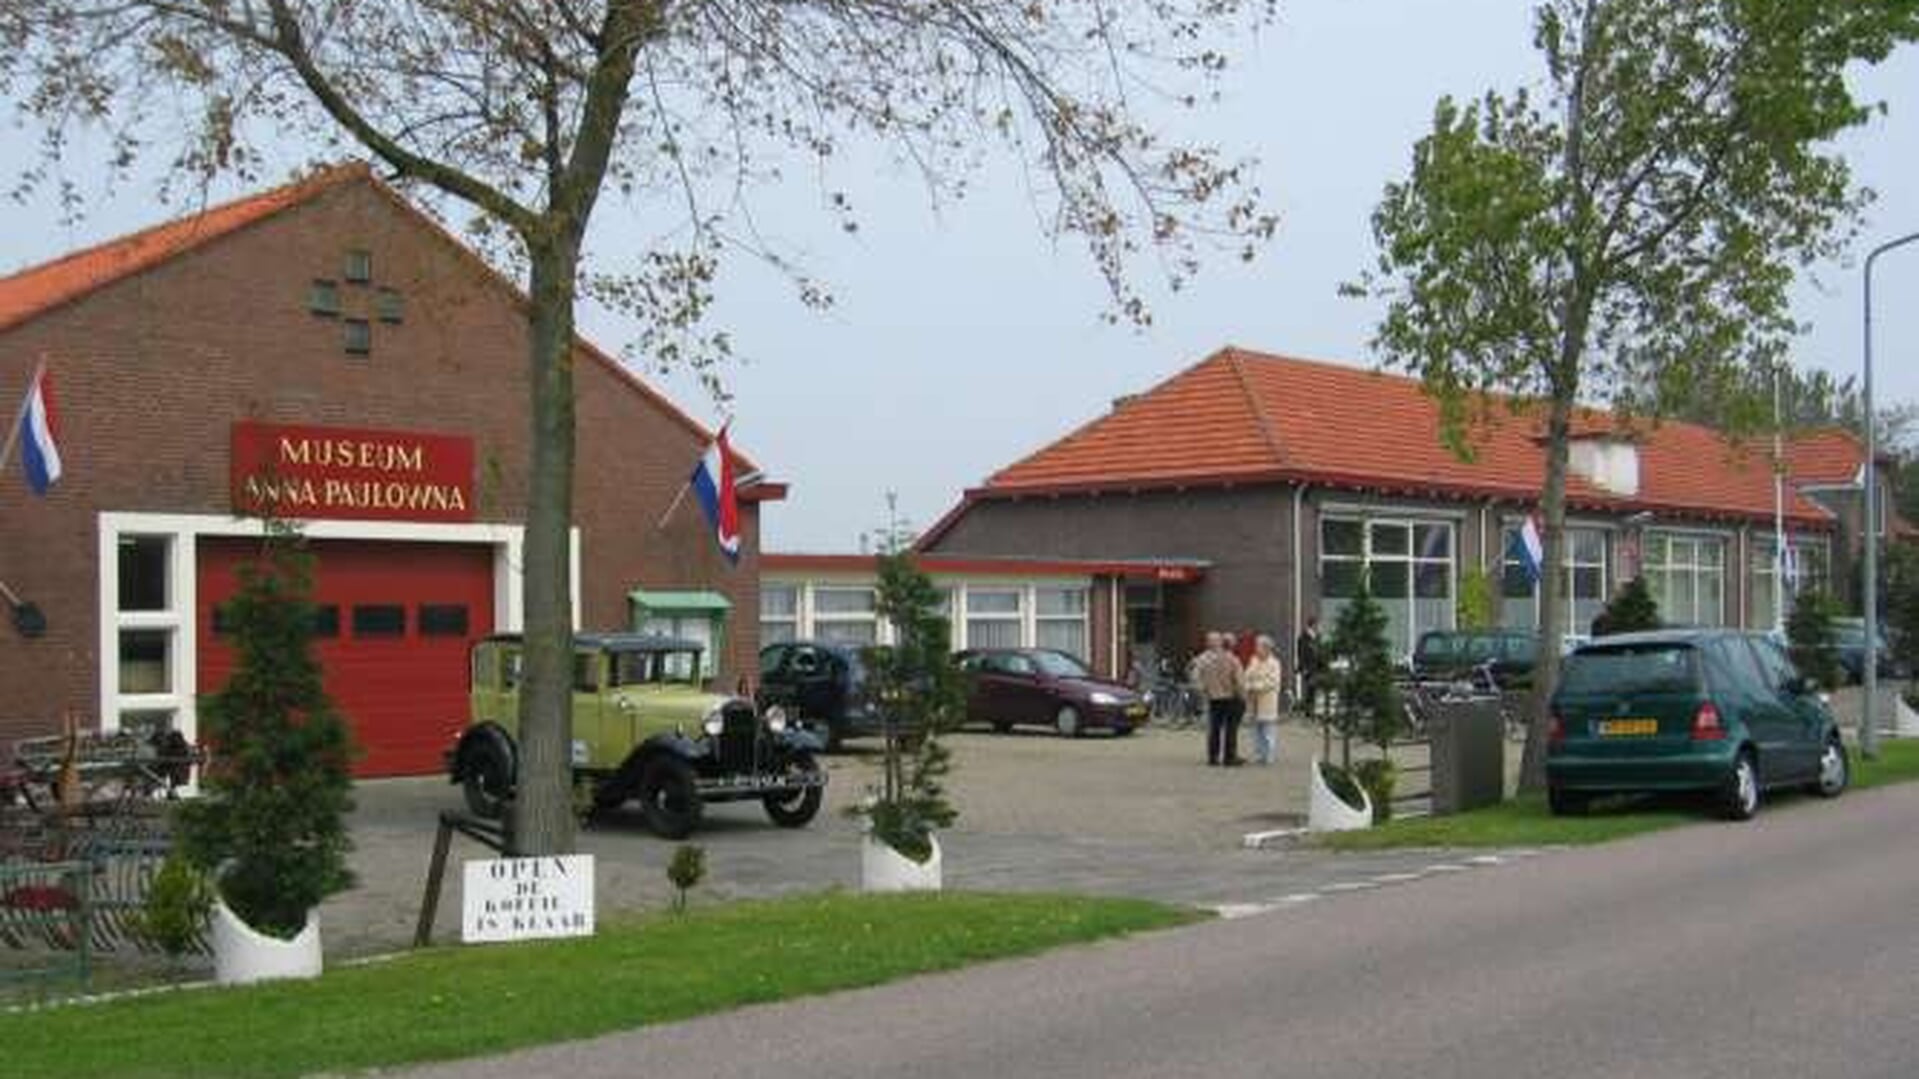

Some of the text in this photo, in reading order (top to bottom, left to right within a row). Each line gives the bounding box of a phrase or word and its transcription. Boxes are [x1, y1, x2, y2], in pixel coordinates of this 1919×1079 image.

[280, 437, 423, 471] MUSEUM
[245, 473, 465, 511] ANNA PAULOWNA
[490, 858, 571, 879] OPEN
